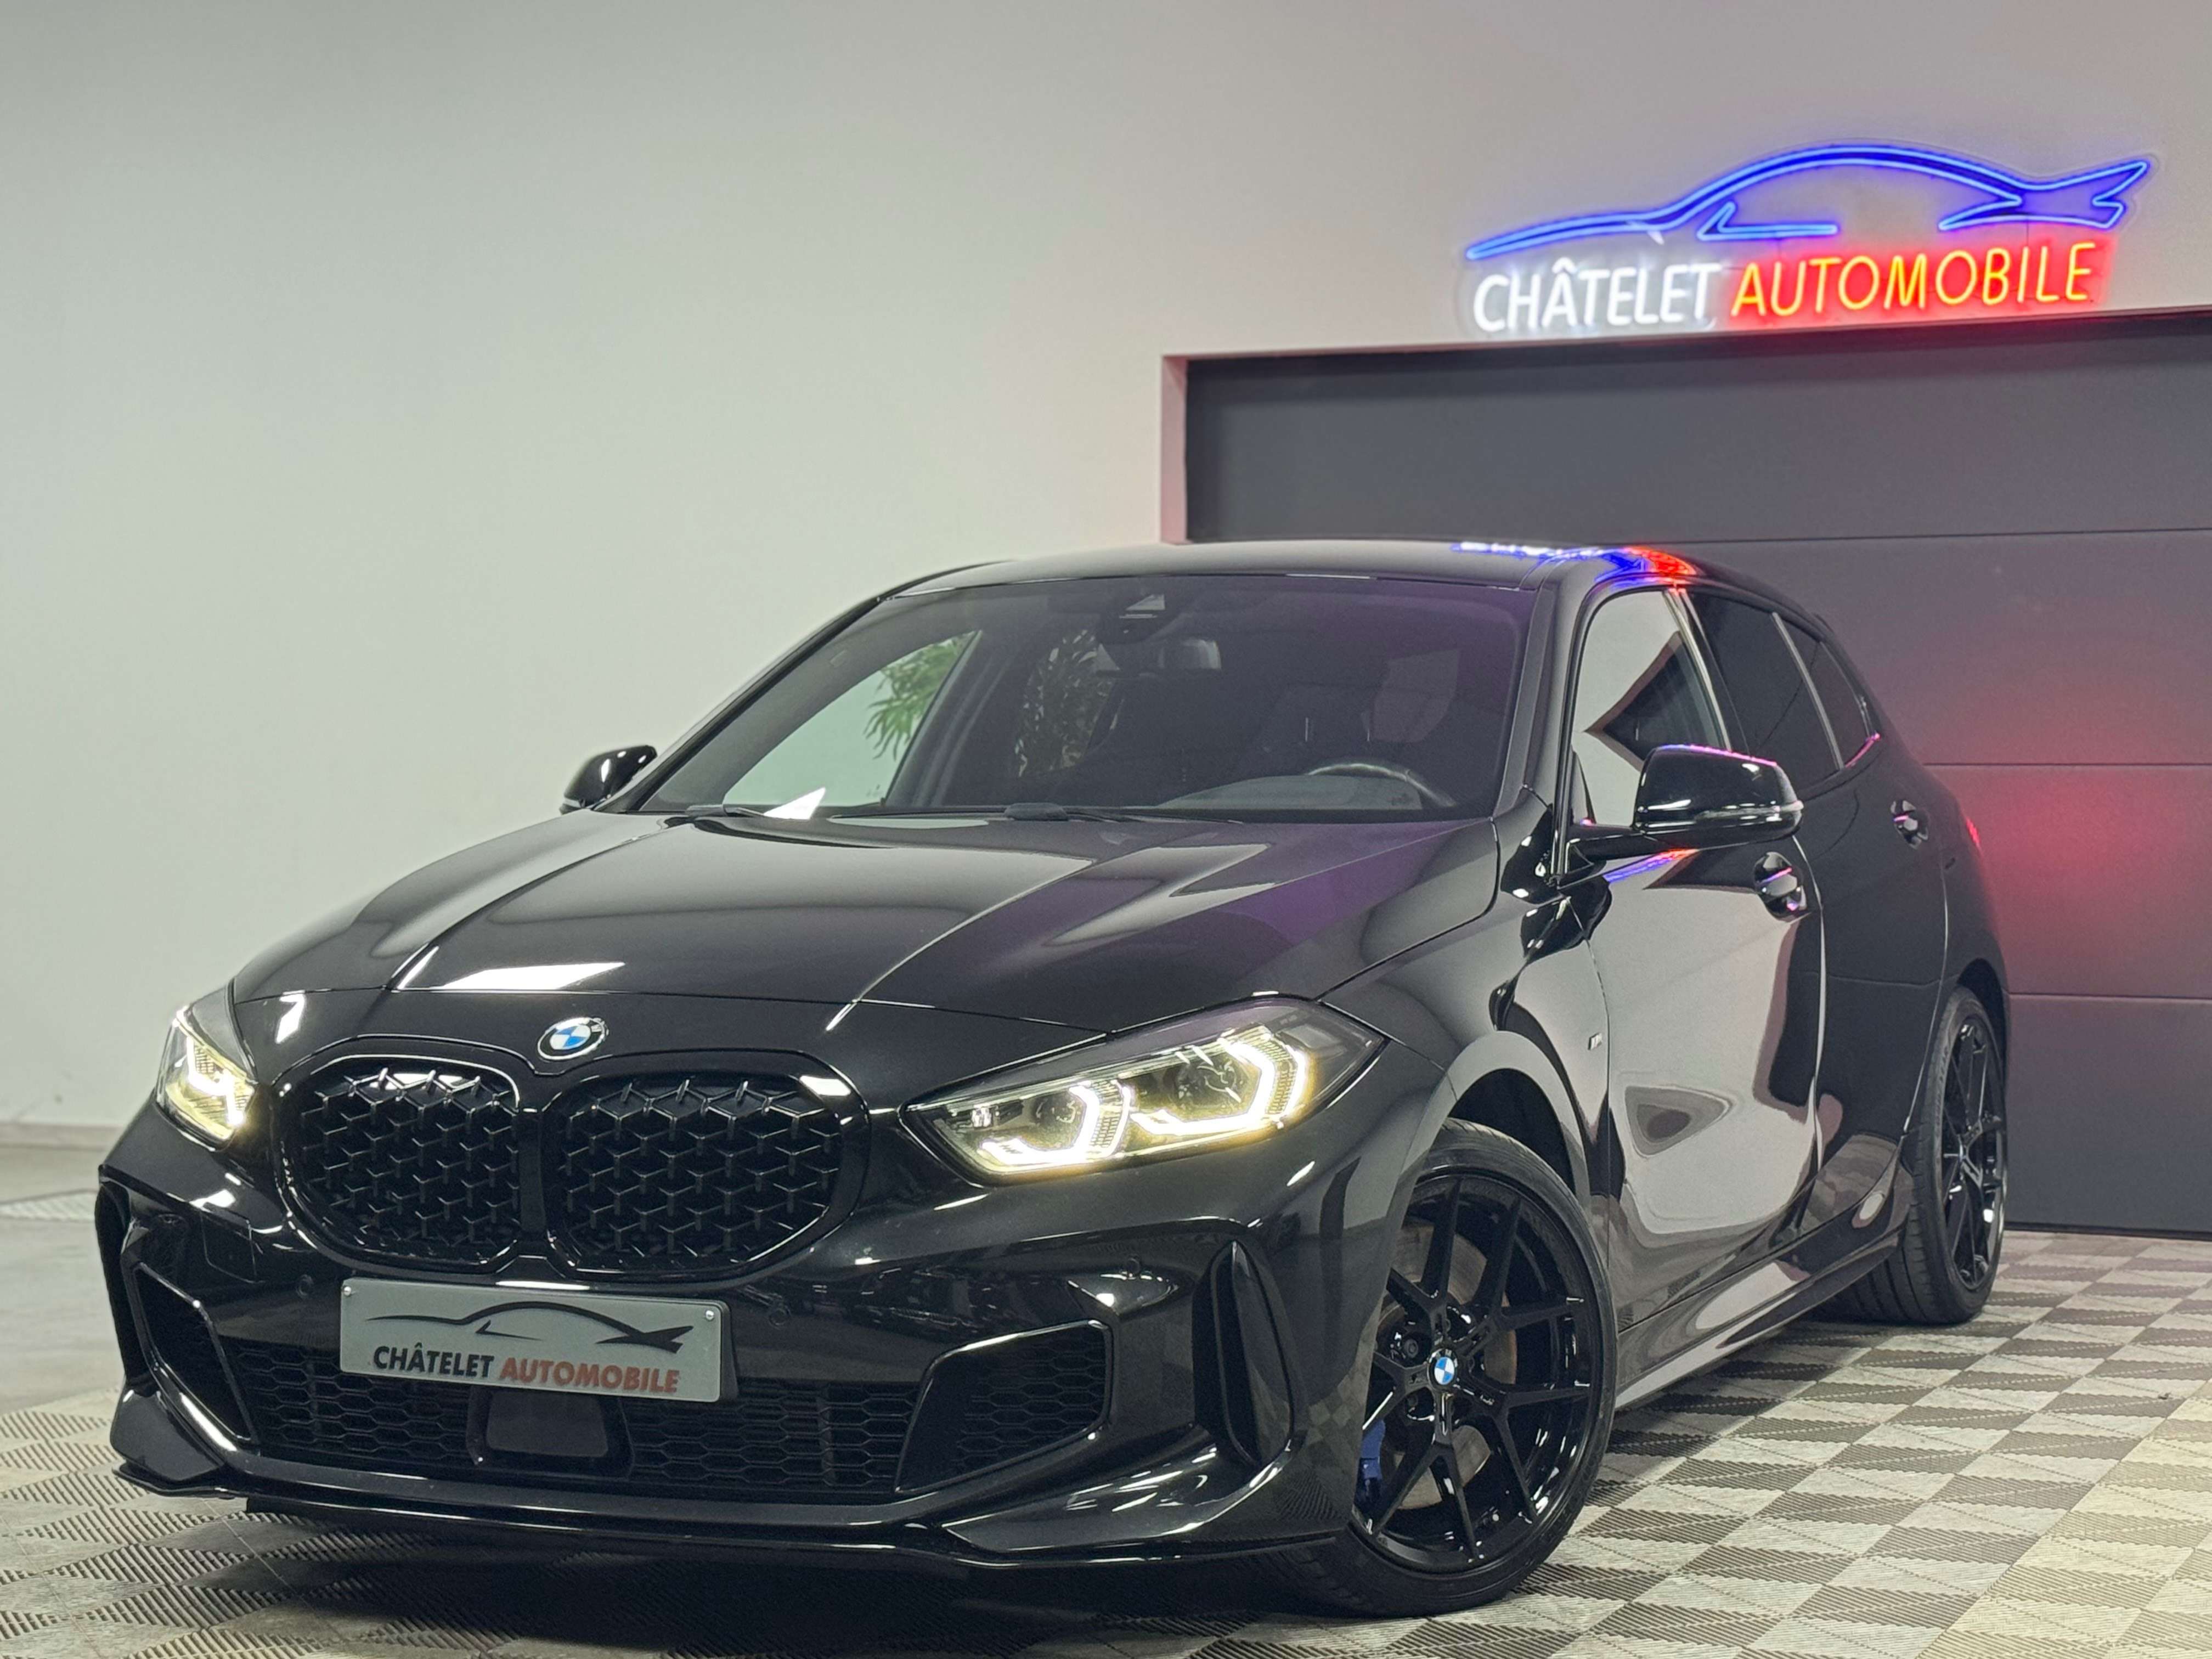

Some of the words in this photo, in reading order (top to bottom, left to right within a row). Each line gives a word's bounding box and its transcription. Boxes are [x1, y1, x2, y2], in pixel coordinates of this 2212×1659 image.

[1474, 257, 1722, 332] CHÂTELET
[1731, 243, 2096, 317] AUTOMOBILE
[374, 1342, 495, 1378] CHÂTELET
[499, 1357, 680, 1393] AUTOMOBILE
